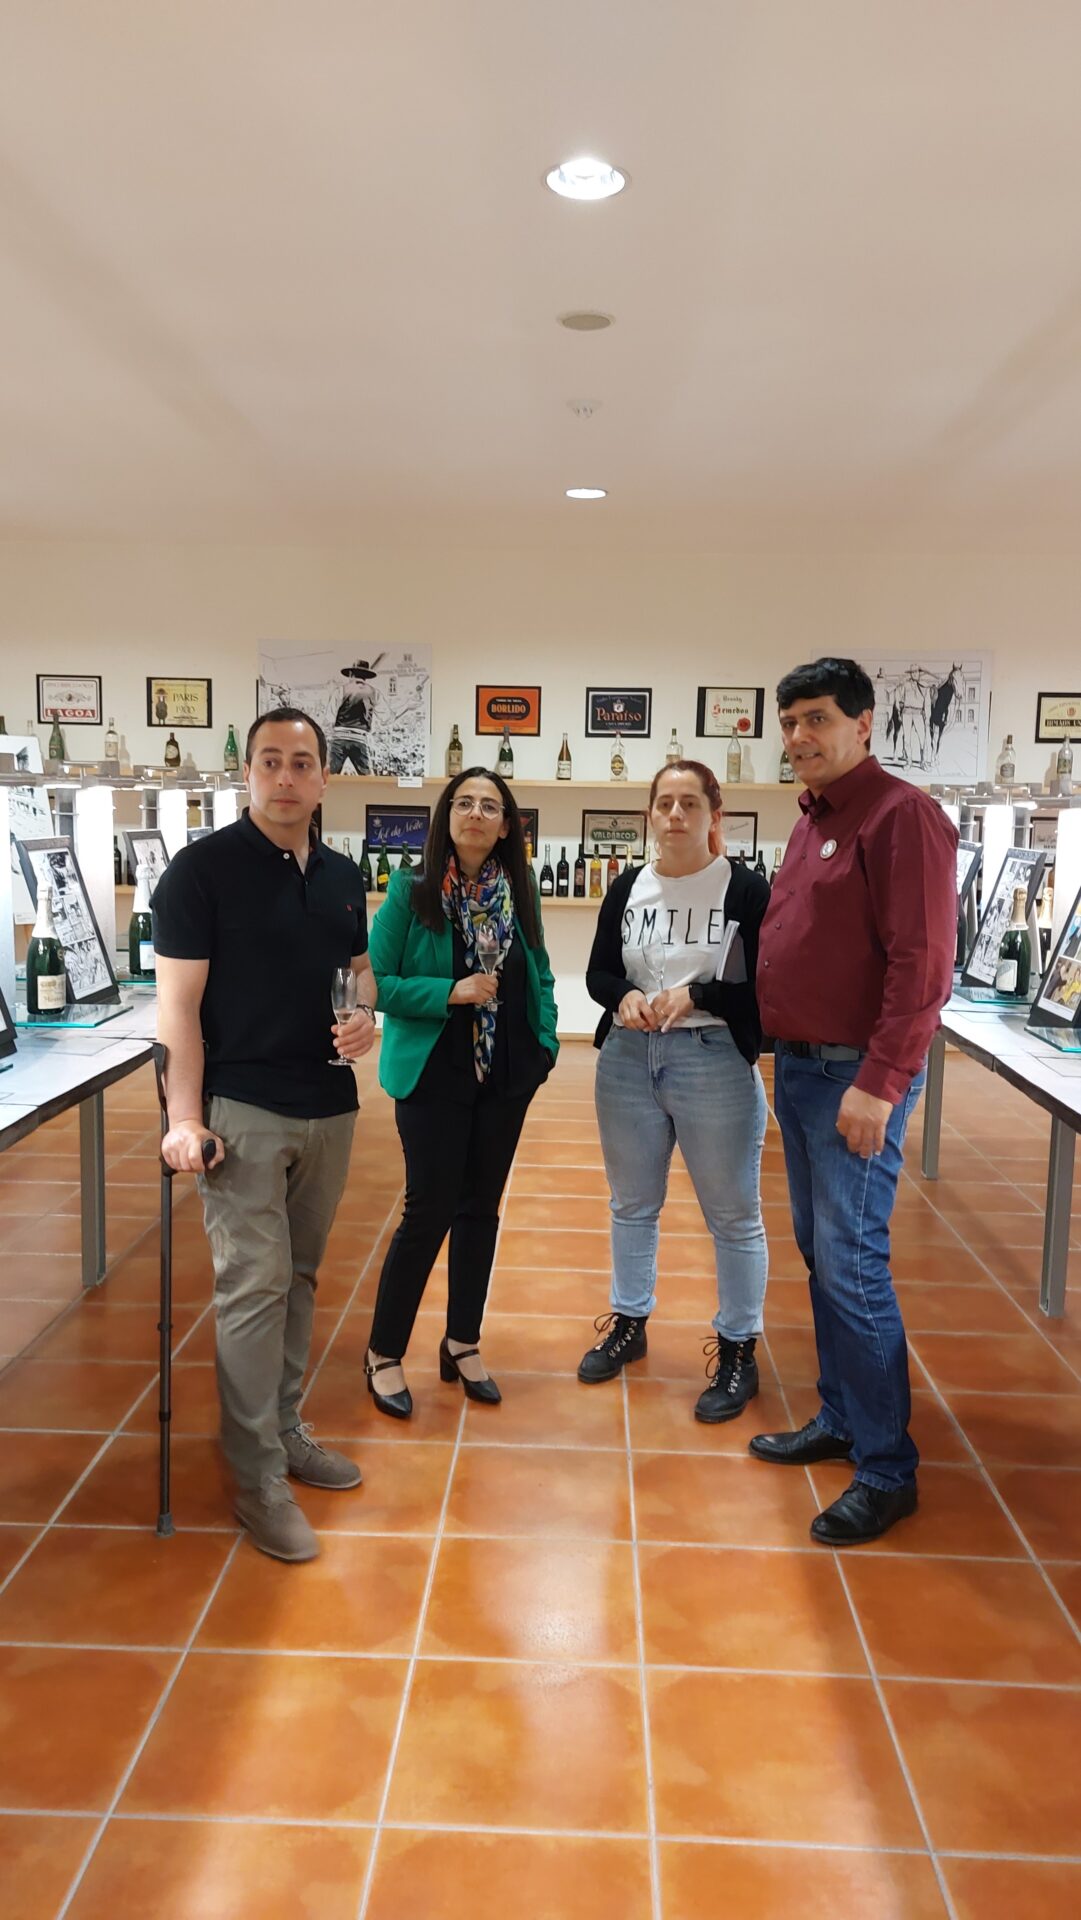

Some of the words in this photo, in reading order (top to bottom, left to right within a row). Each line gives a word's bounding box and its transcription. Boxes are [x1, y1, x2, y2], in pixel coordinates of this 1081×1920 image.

[173, 693, 199, 701] PARIS
[491, 704, 526, 713] BORLIDO
[47, 709, 94, 717] LAGOA
[623, 908, 722, 946] SMILE
